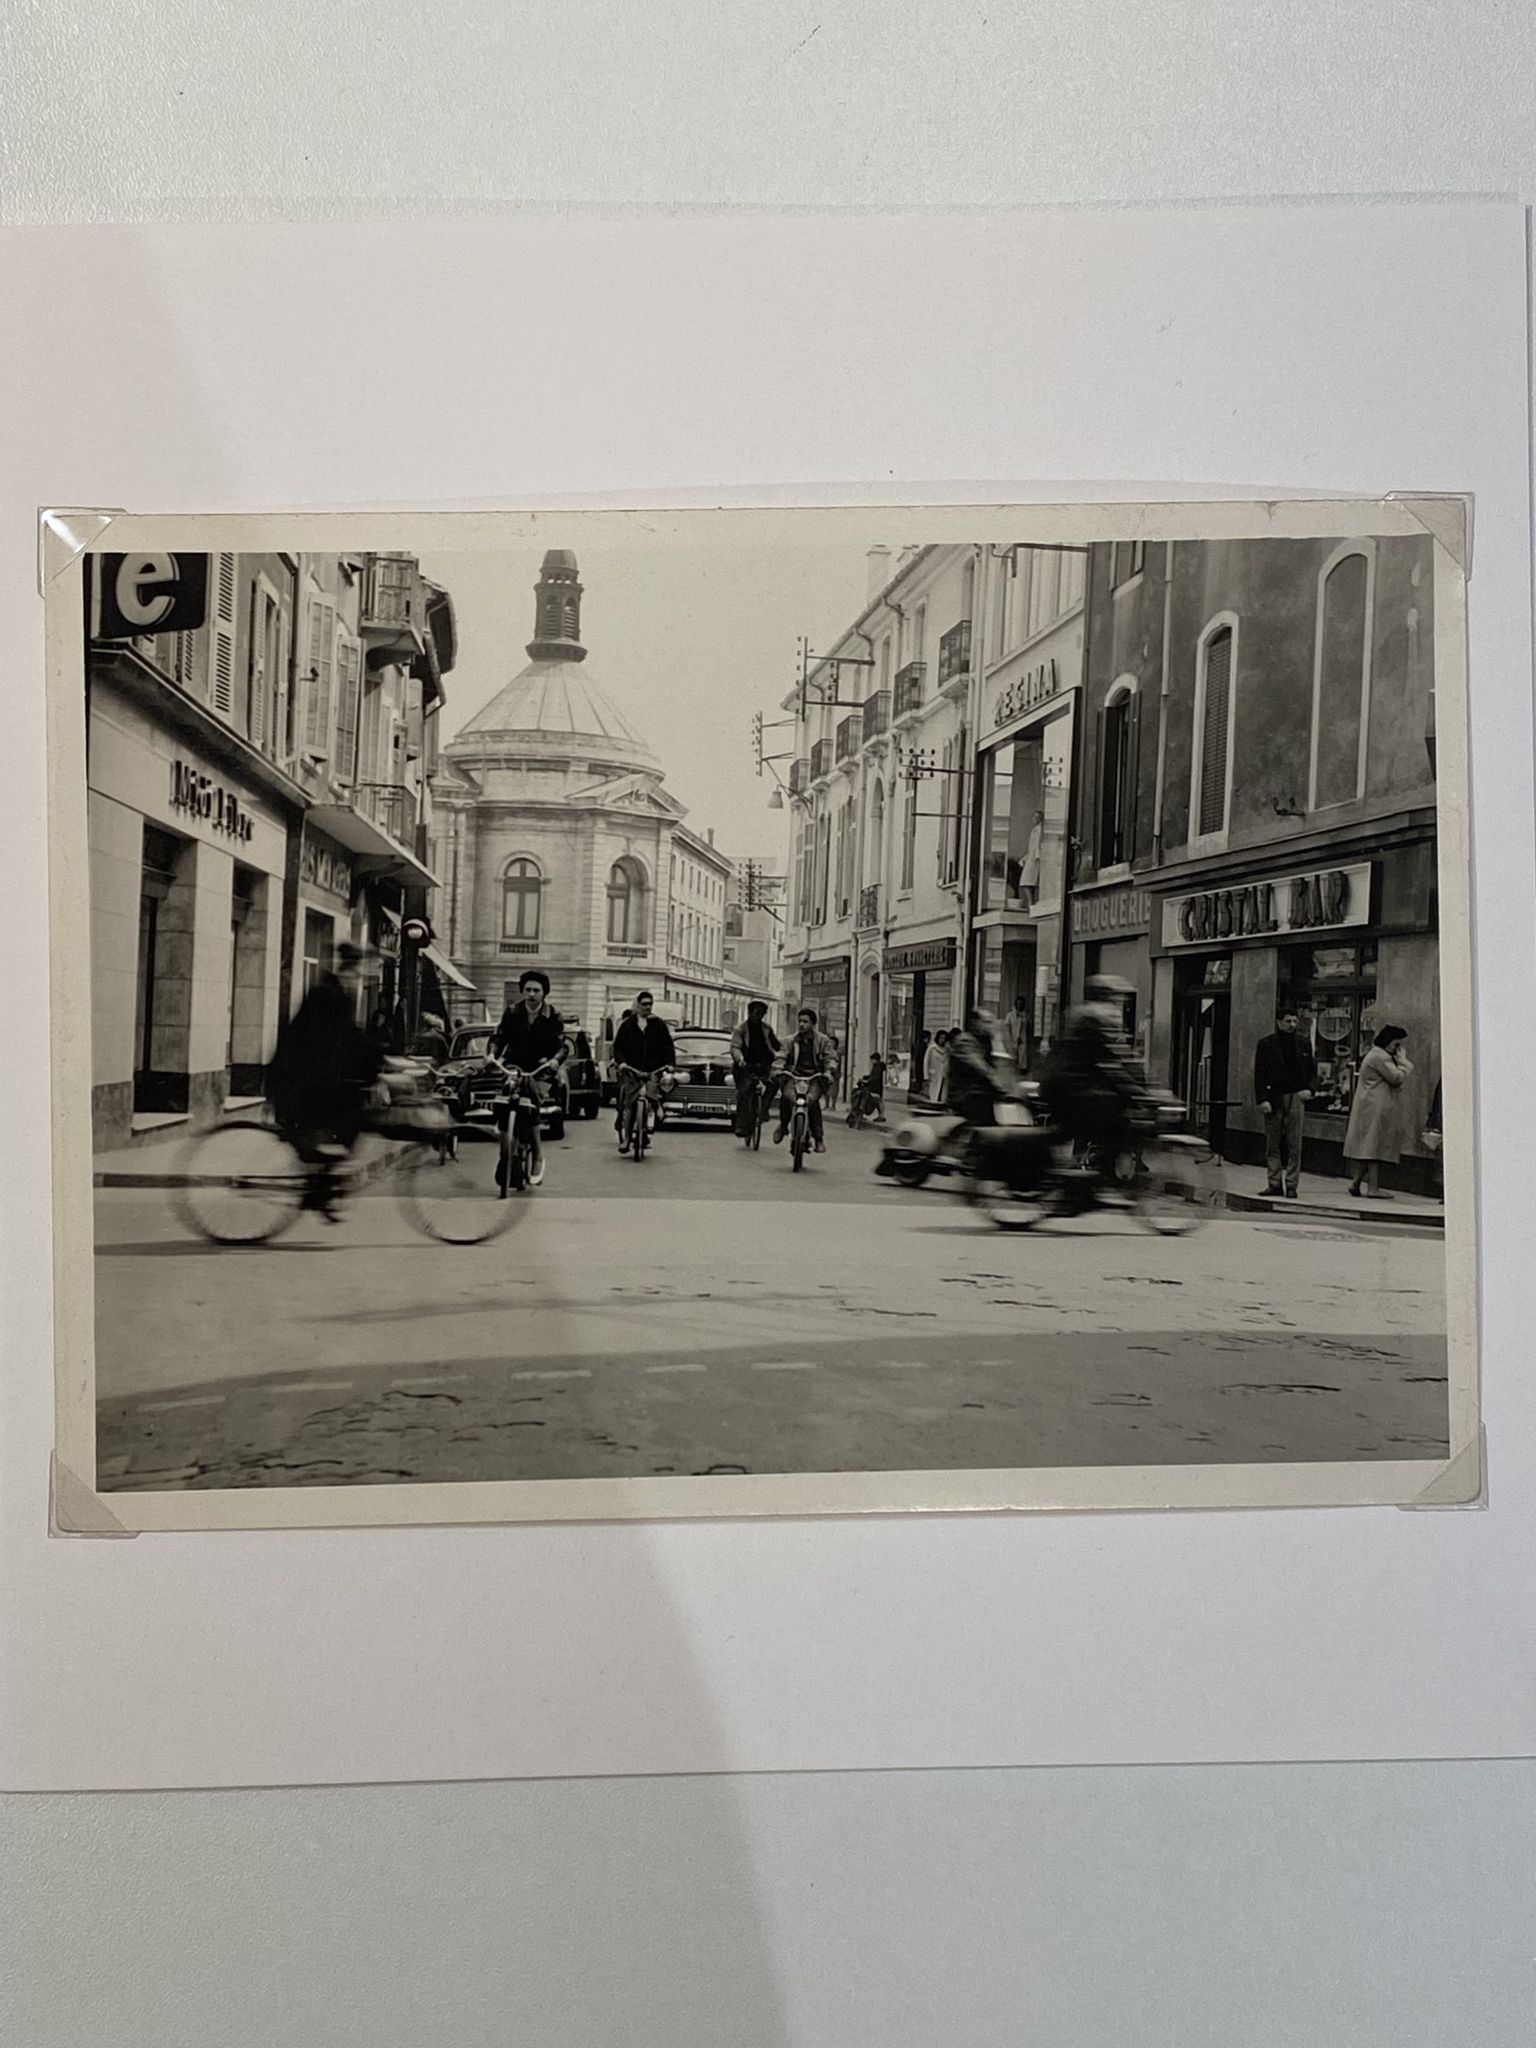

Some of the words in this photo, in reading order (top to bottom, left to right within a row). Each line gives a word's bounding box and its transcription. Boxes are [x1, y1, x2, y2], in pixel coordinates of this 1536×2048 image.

[115, 552, 180, 626] e
[1073, 891, 1152, 932] DROGUERIE
[1178, 884, 1278, 941] CRISTAL
[1289, 870, 1349, 929] BAR
